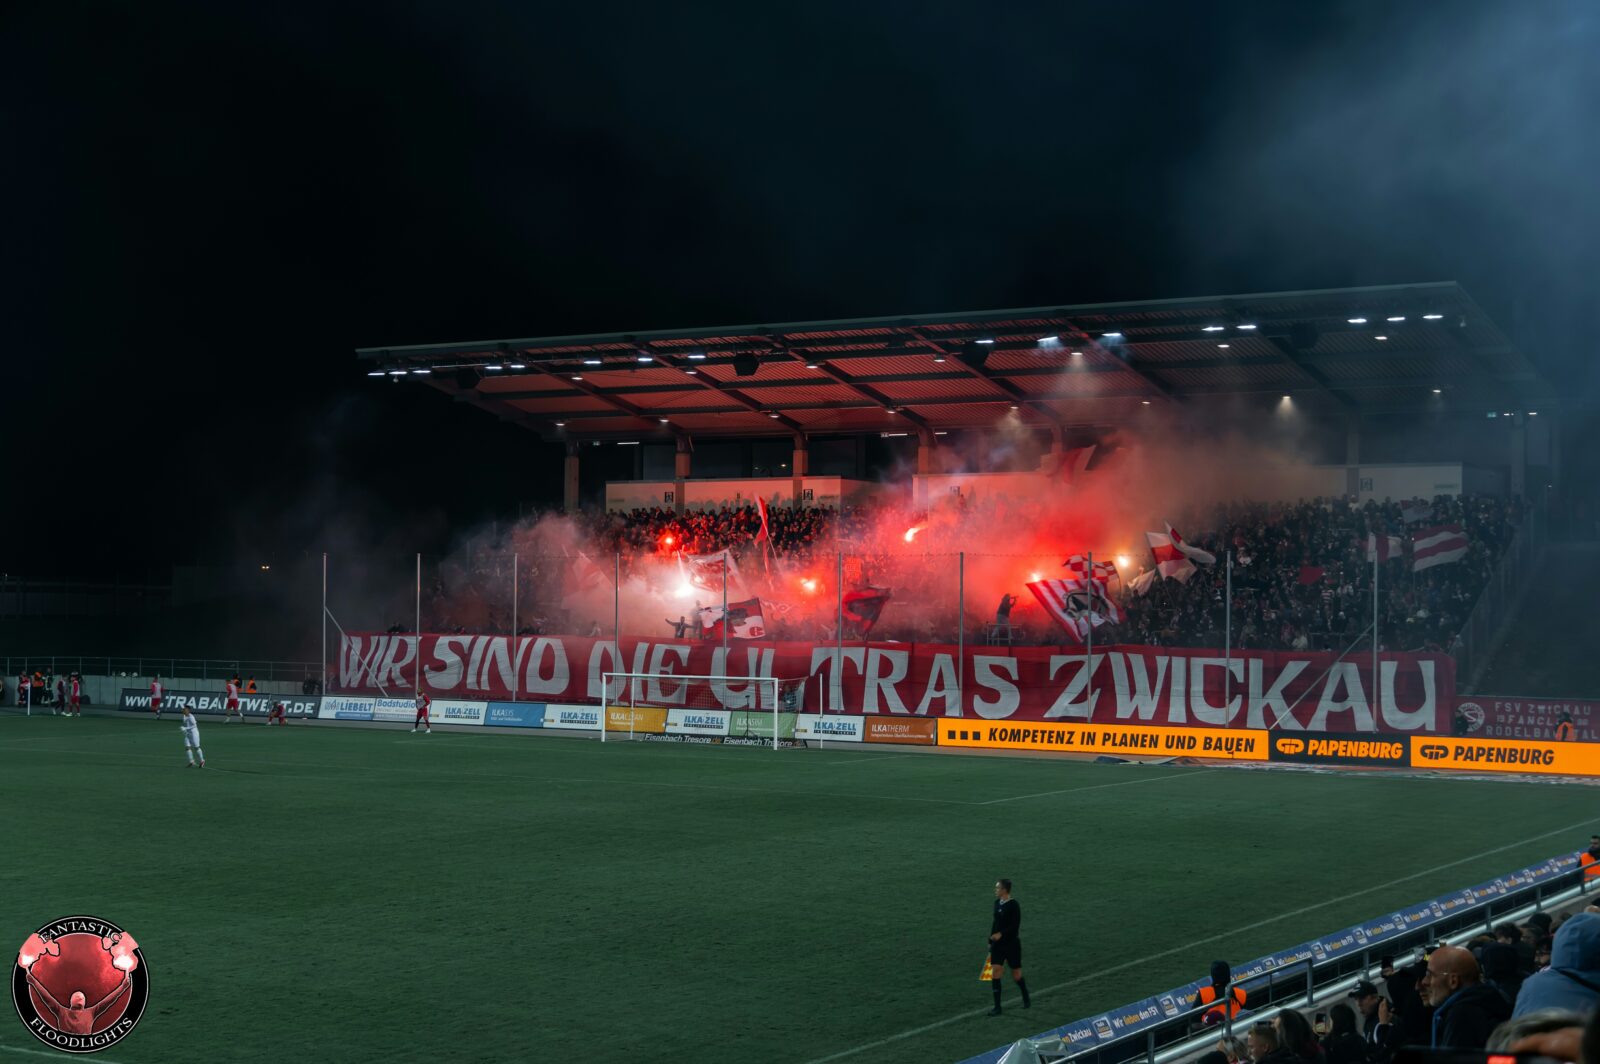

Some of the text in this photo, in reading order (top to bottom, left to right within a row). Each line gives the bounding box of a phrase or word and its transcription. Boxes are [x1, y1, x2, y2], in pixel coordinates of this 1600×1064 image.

[339, 635, 421, 689] WIR
[424, 635, 570, 695] SIND
[588, 640, 692, 705] DIE
[710, 646, 1020, 719] ULTRAS
[1043, 652, 1434, 731] ZWICKAU
[1495, 702, 1591, 715] FSV ZWICKAU
[872, 724, 910, 733] ILKATHERM
[988, 727, 1255, 753] KOMPETENZ IN PLANEN UND BAUEN
[1307, 739, 1404, 759] PAPENBURG
[1453, 745, 1555, 765] PAPENBURG
